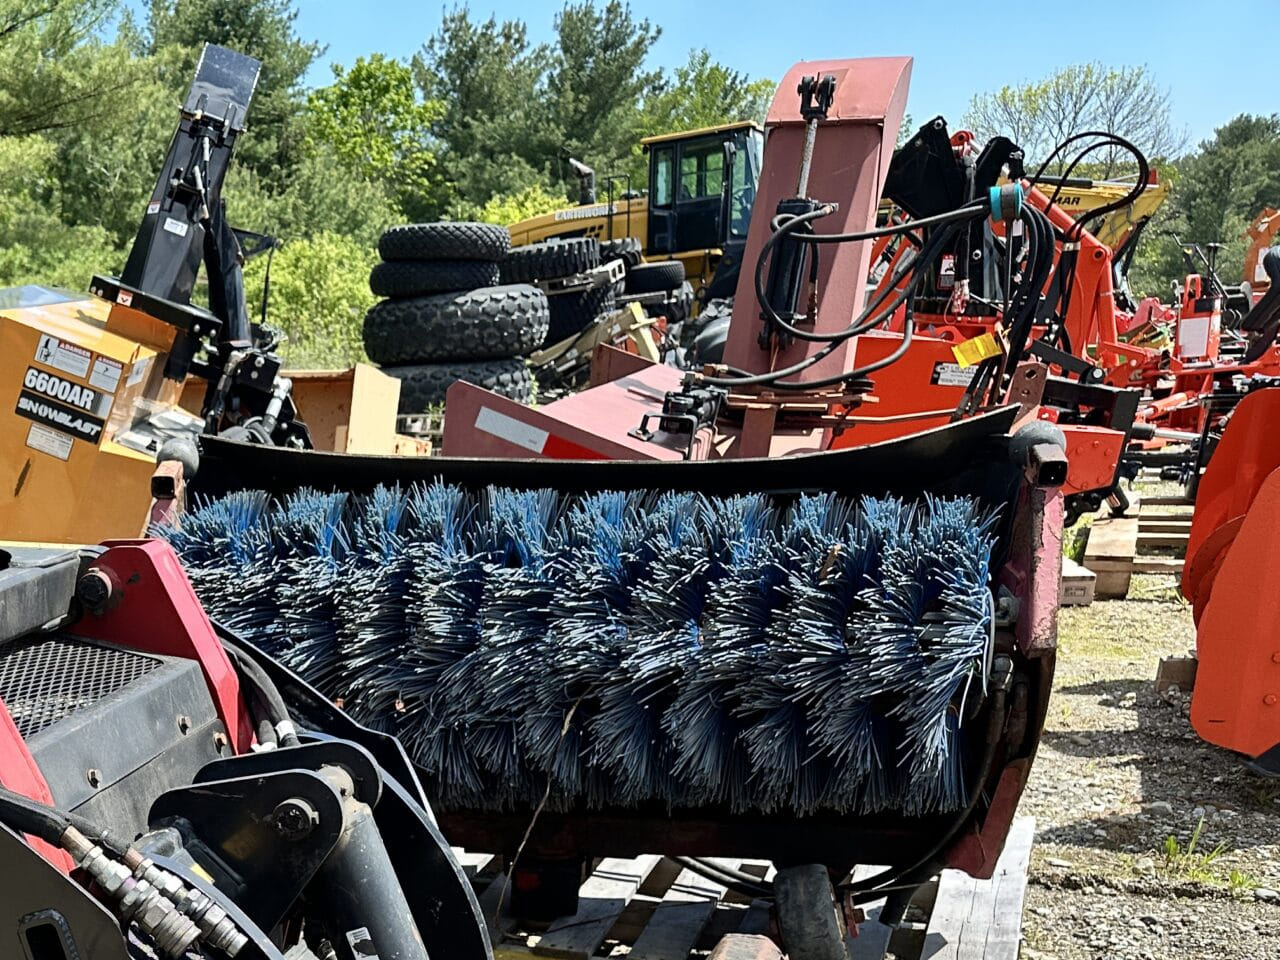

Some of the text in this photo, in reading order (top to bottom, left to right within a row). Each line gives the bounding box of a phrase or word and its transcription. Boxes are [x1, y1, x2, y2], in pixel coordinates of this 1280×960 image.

[1050, 196, 1081, 205] MAR
[65, 343, 91, 359] DANGER
[24, 367, 96, 411] 6600AR
[17, 397, 102, 436] SNOWBLAST
